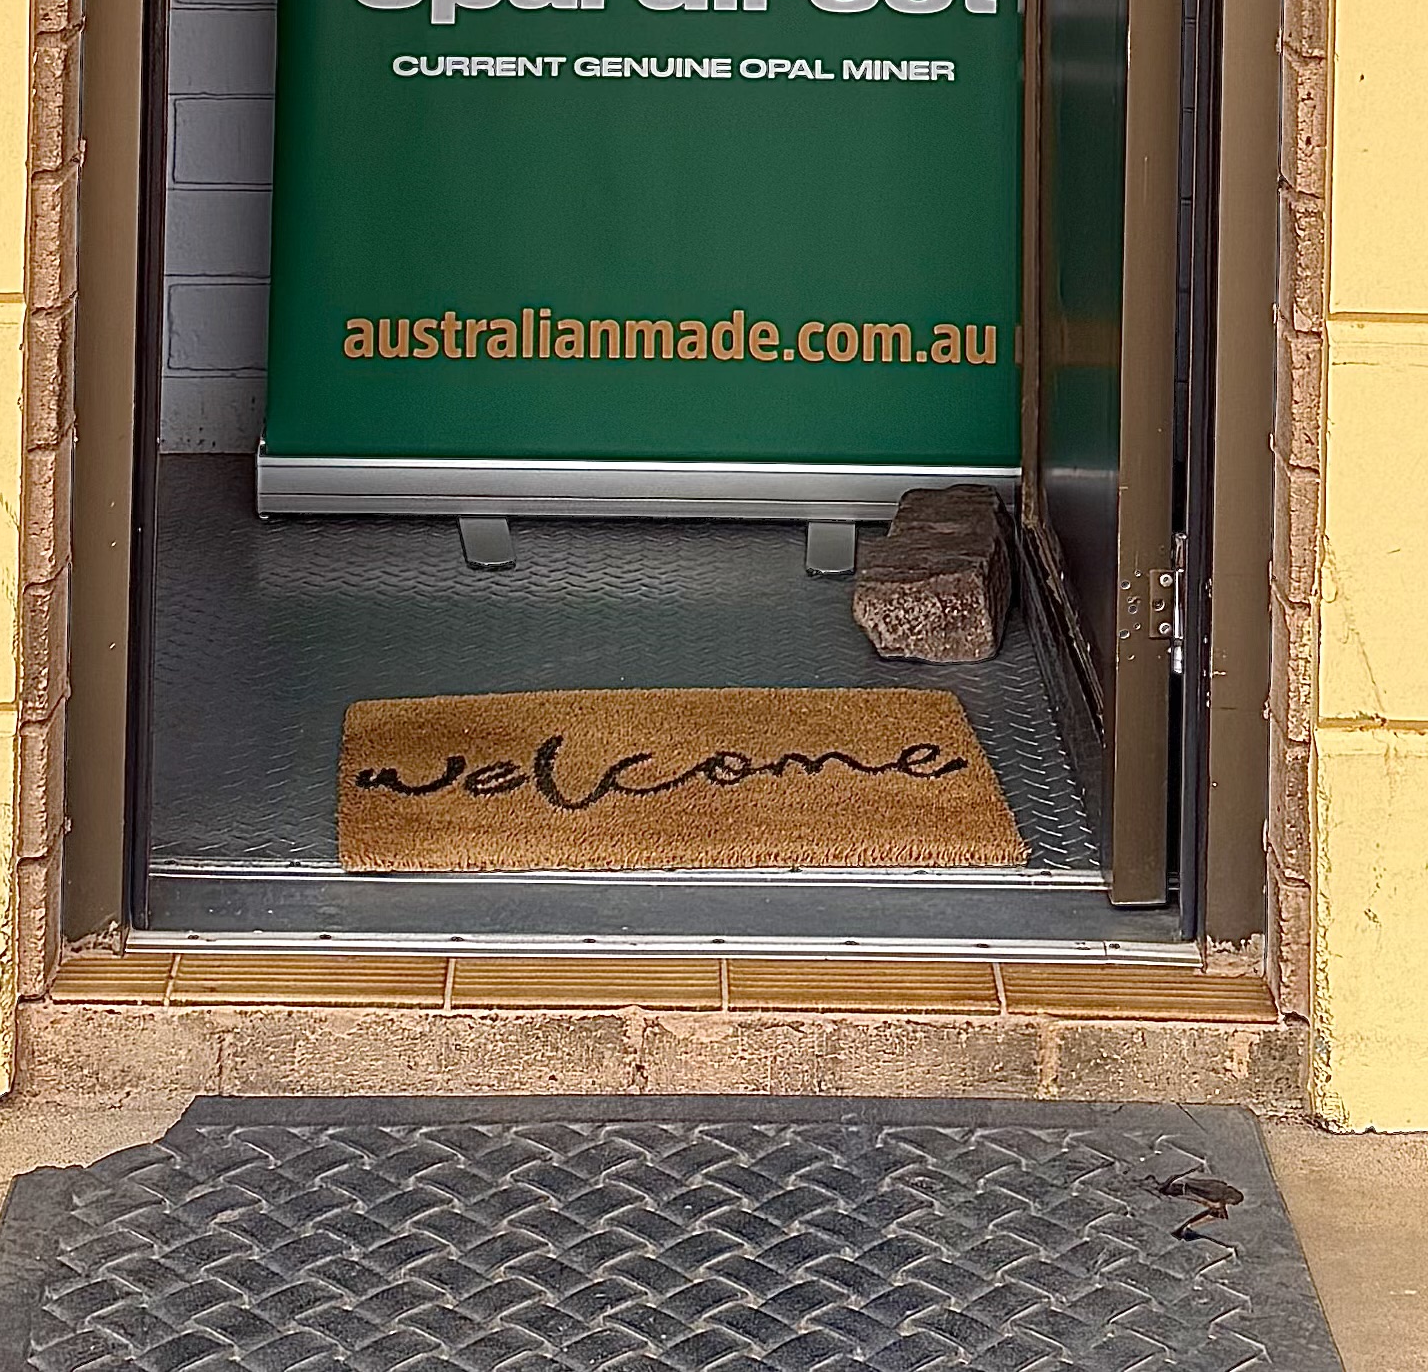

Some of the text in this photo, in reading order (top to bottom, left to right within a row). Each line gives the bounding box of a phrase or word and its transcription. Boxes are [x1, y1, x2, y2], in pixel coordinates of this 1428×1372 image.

[391, 55, 956, 82] CURRENT GENUINE OPAL MINER
[343, 308, 999, 365] australianmade.com.au
[353, 733, 970, 812] welcome
